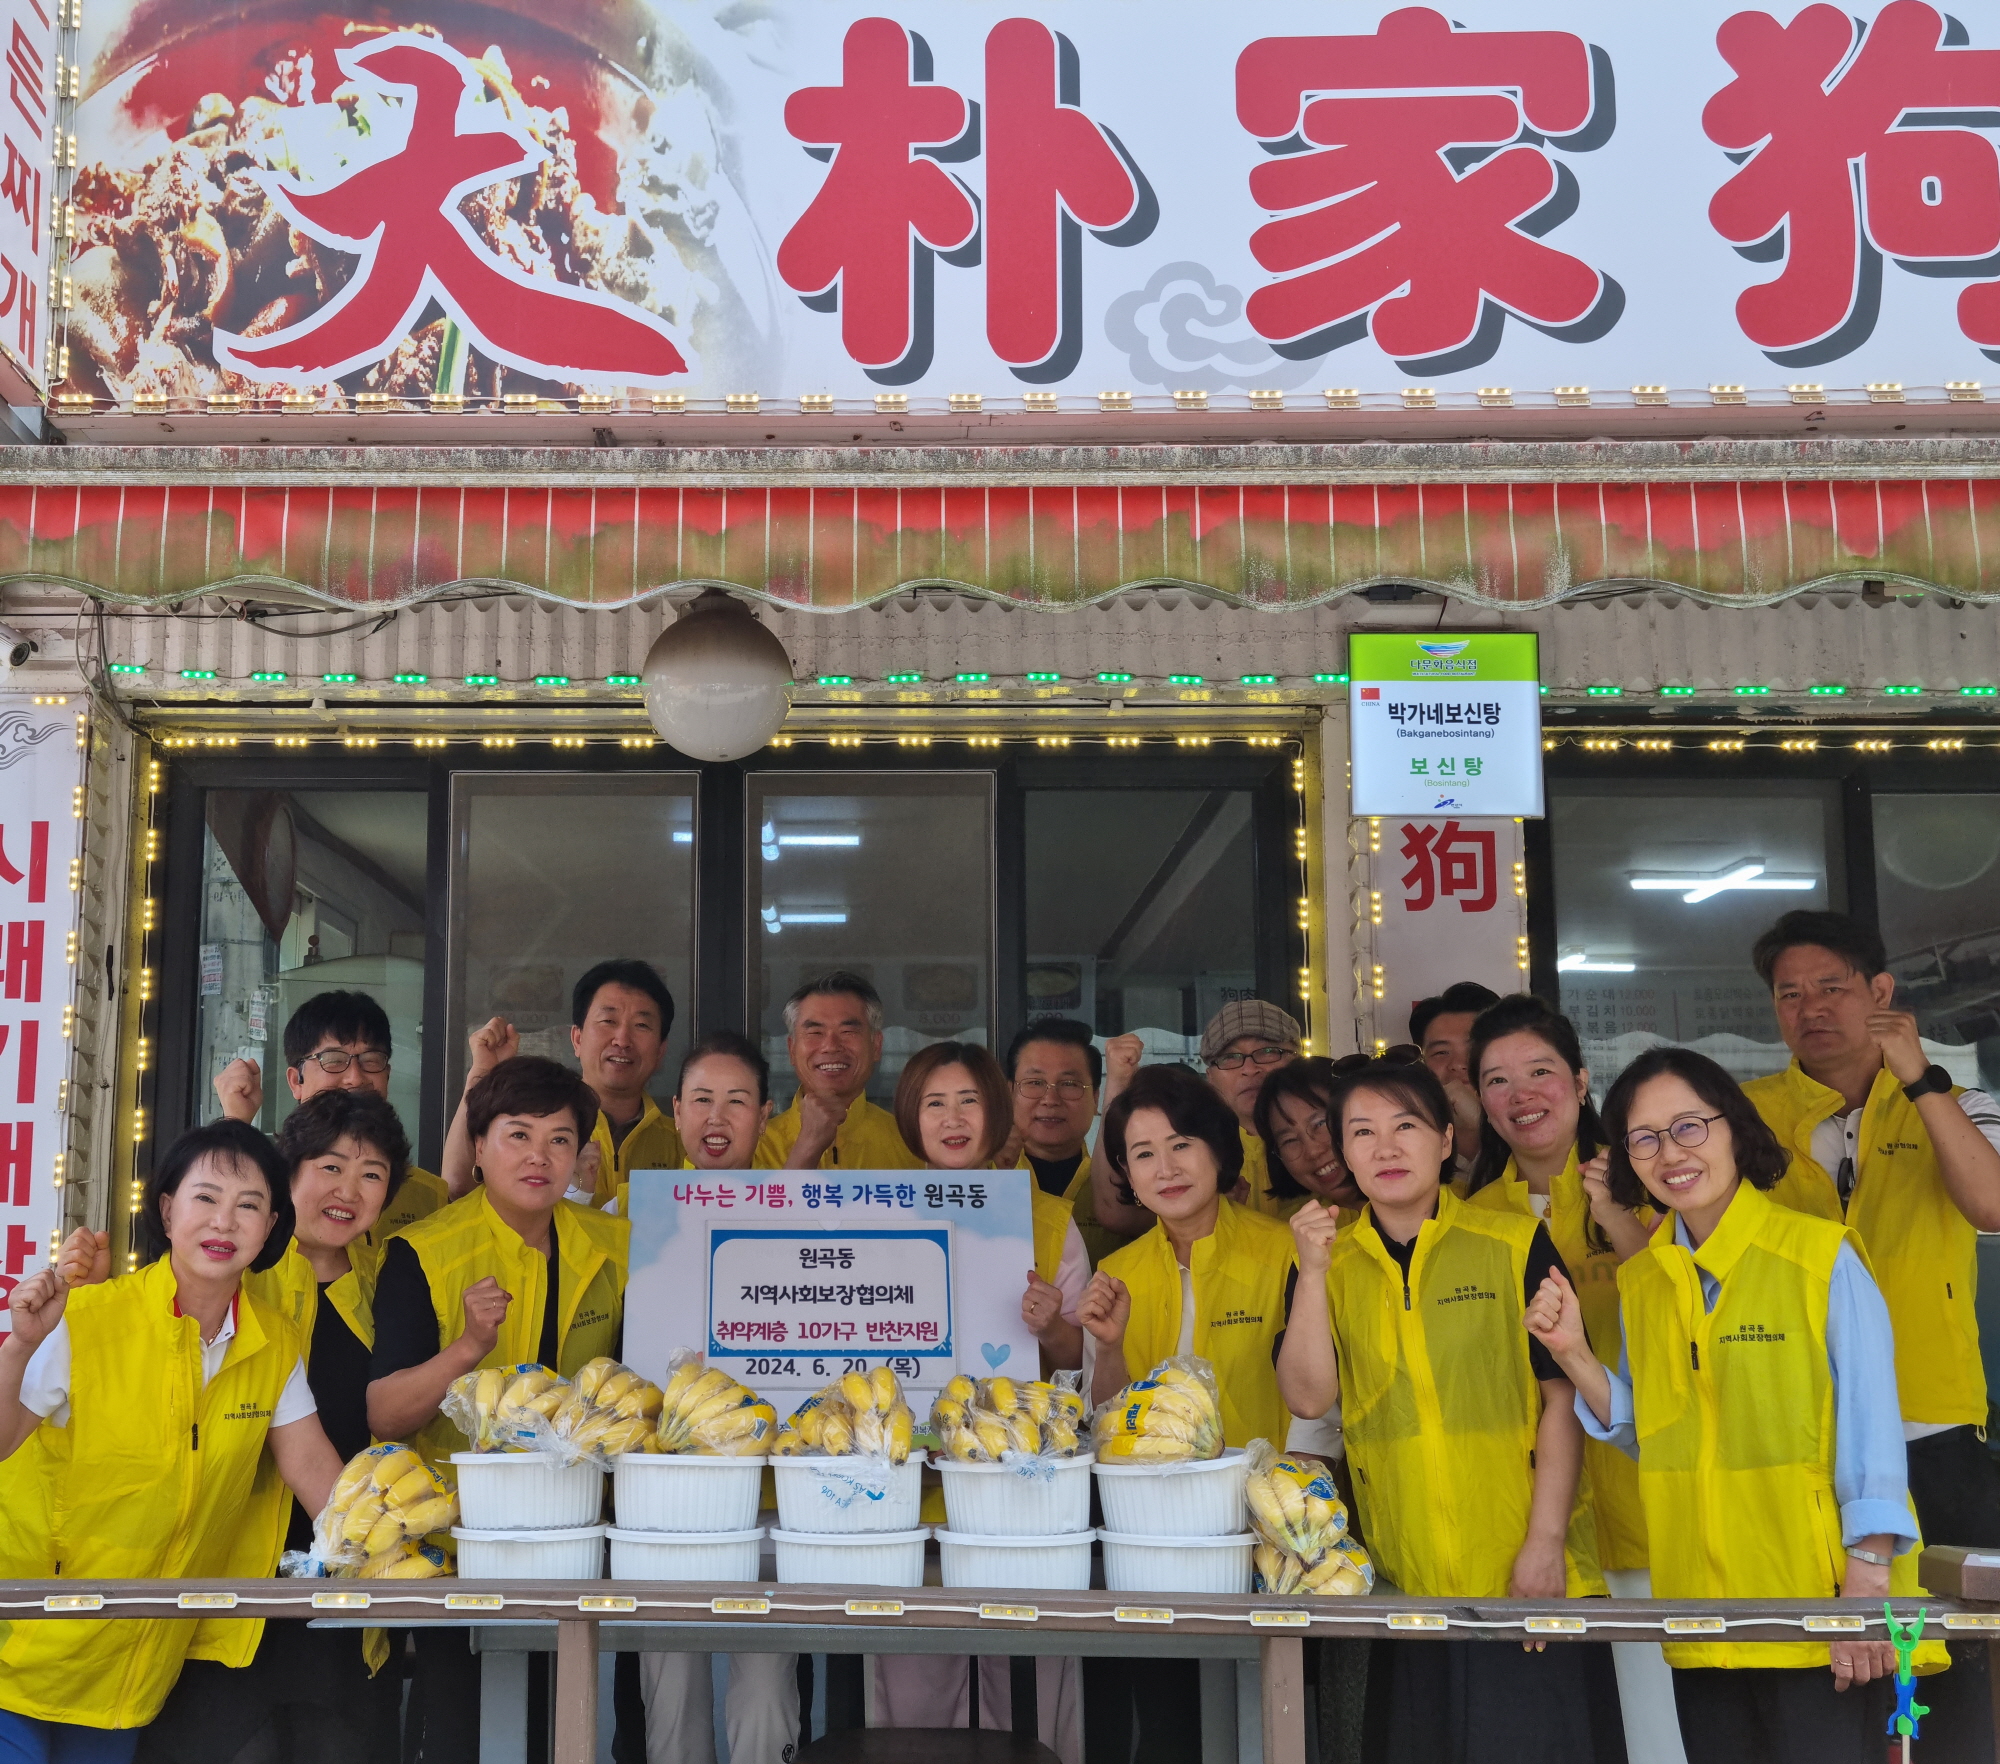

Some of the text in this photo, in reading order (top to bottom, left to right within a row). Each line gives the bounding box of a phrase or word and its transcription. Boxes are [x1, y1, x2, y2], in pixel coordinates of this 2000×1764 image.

[1410, 659, 1477, 670] 다문화음식점
[1387, 702, 1502, 726] 박가네보신탕
[1396, 728, 1496, 739] (Bakganebosintang)
[1423, 778, 1471, 788] (Bosintang)
[1400, 820, 1498, 913] 狗
[672, 1182, 988, 1209] 나누는 기쁨, 행복 가득한 원곡동
[798, 1247, 856, 1270] 원곡동
[740, 1284, 914, 1306] 지역사회보장협의체
[716, 1321, 940, 1343] 취약계층 10가구 반찬지원
[745, 1358, 801, 1377] 2024.
[812, 1358, 831, 1377] 6.
[886, 1356, 921, 1379] (목)
